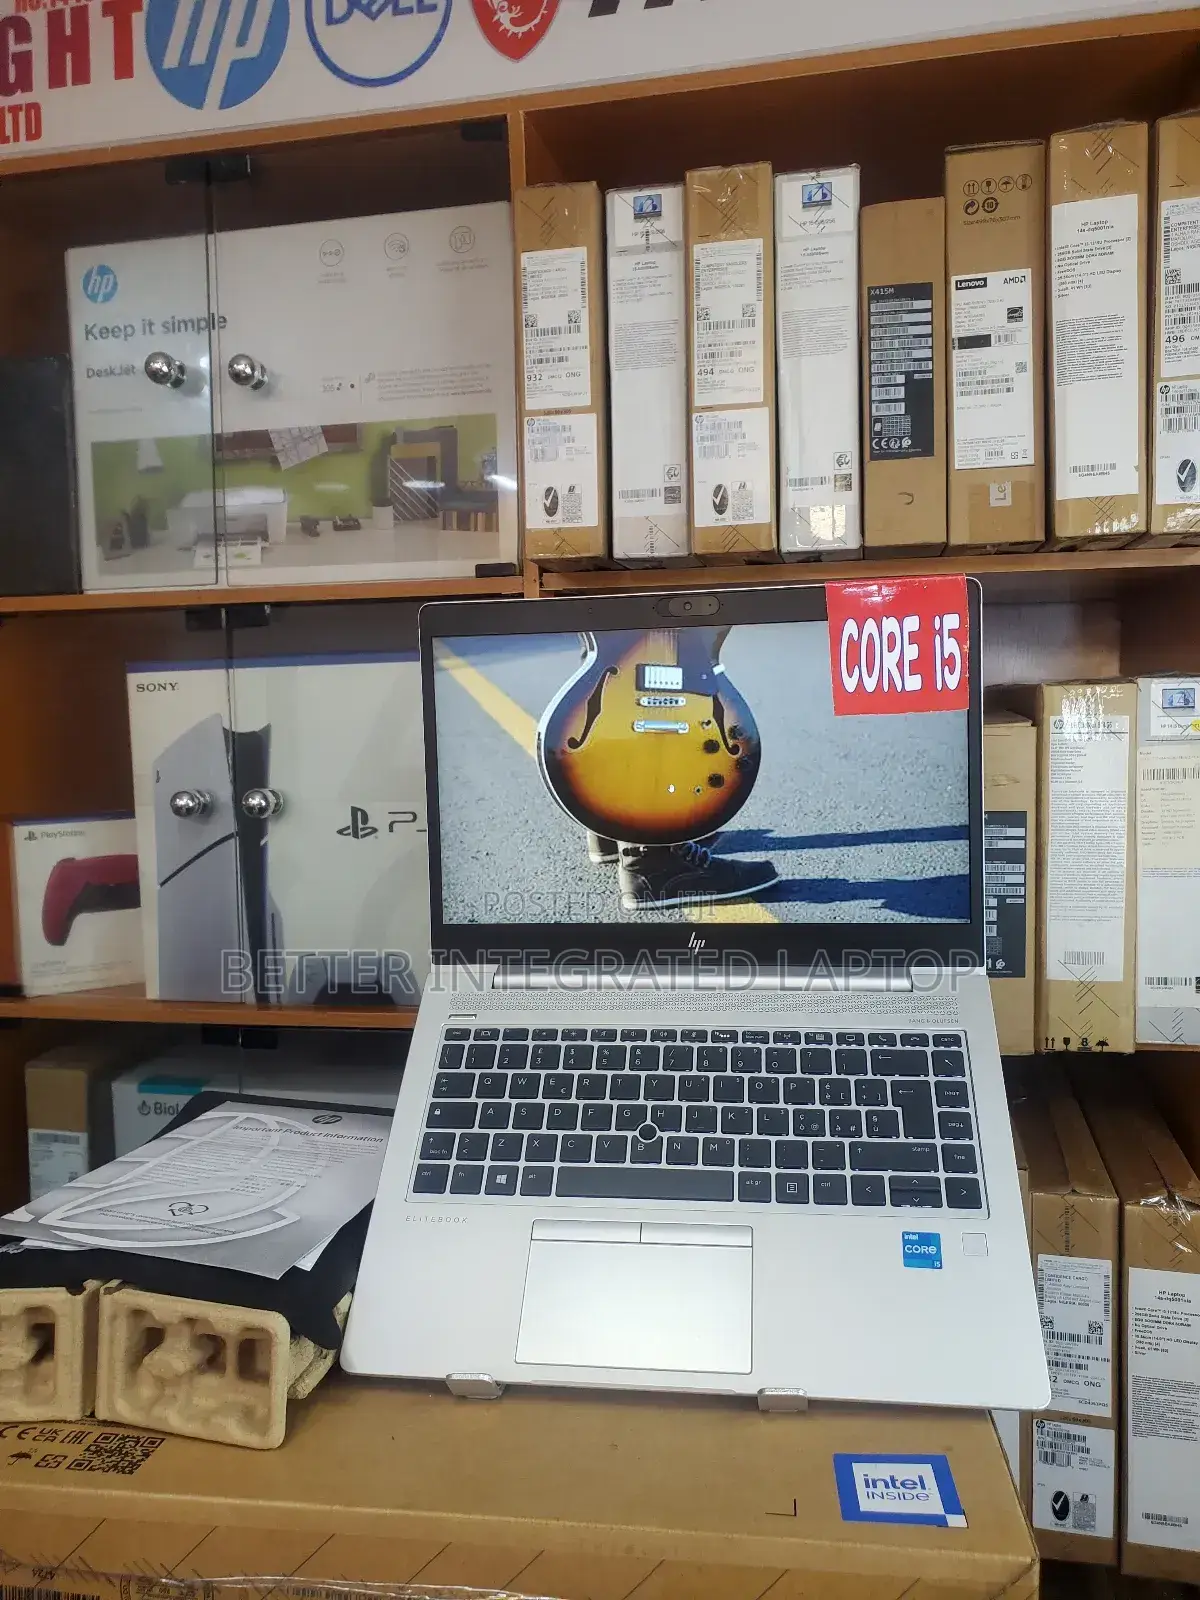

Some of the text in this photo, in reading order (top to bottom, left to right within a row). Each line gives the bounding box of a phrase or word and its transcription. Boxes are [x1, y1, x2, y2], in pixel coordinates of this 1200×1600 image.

[83, 264, 118, 304] hp
[957, 280, 985, 288] Lenovo
[1003, 276, 1020, 285] AMD
[84, 312, 228, 341] Keep it simple
[1165, 335, 1186, 344] 496
[697, 367, 714, 376] 494
[526, 373, 543, 382] 932
[840, 612, 962, 693] CORE i5
[136, 682, 178, 693] SONY
[483, 1077, 492, 1085] Q
[517, 1077, 528, 1085] W
[549, 1077, 556, 1085] E
[582, 1078, 590, 1086] R
[616, 1078, 623, 1086] T
[651, 1079, 659, 1087] Y
[685, 1080, 693, 1088] U
[790, 1082, 797, 1090] P
[486, 1107, 495, 1116] A
[520, 1107, 528, 1116] S
[554, 1108, 562, 1116] D
[588, 1108, 595, 1116] F
[623, 1109, 631, 1117] G
[657, 1109, 665, 1118] H
[692, 1111, 699, 1119] J
[728, 1112, 736, 1120] K
[232, 1124, 384, 1144] Important Product Information
[498, 1138, 505, 1147] Z
[532, 1139, 540, 1147] X
[567, 1140, 575, 1148] C
[603, 1140, 611, 1148] V
[637, 1143, 645, 1151] B
[673, 1142, 681, 1150] N
[709, 1143, 718, 1151] M
[405, 1215, 469, 1224] ELITEBOOK
[904, 1233, 919, 1241] intel
[1083, 1380, 1102, 1388] ONG
[862, 1473, 928, 1491] intel
